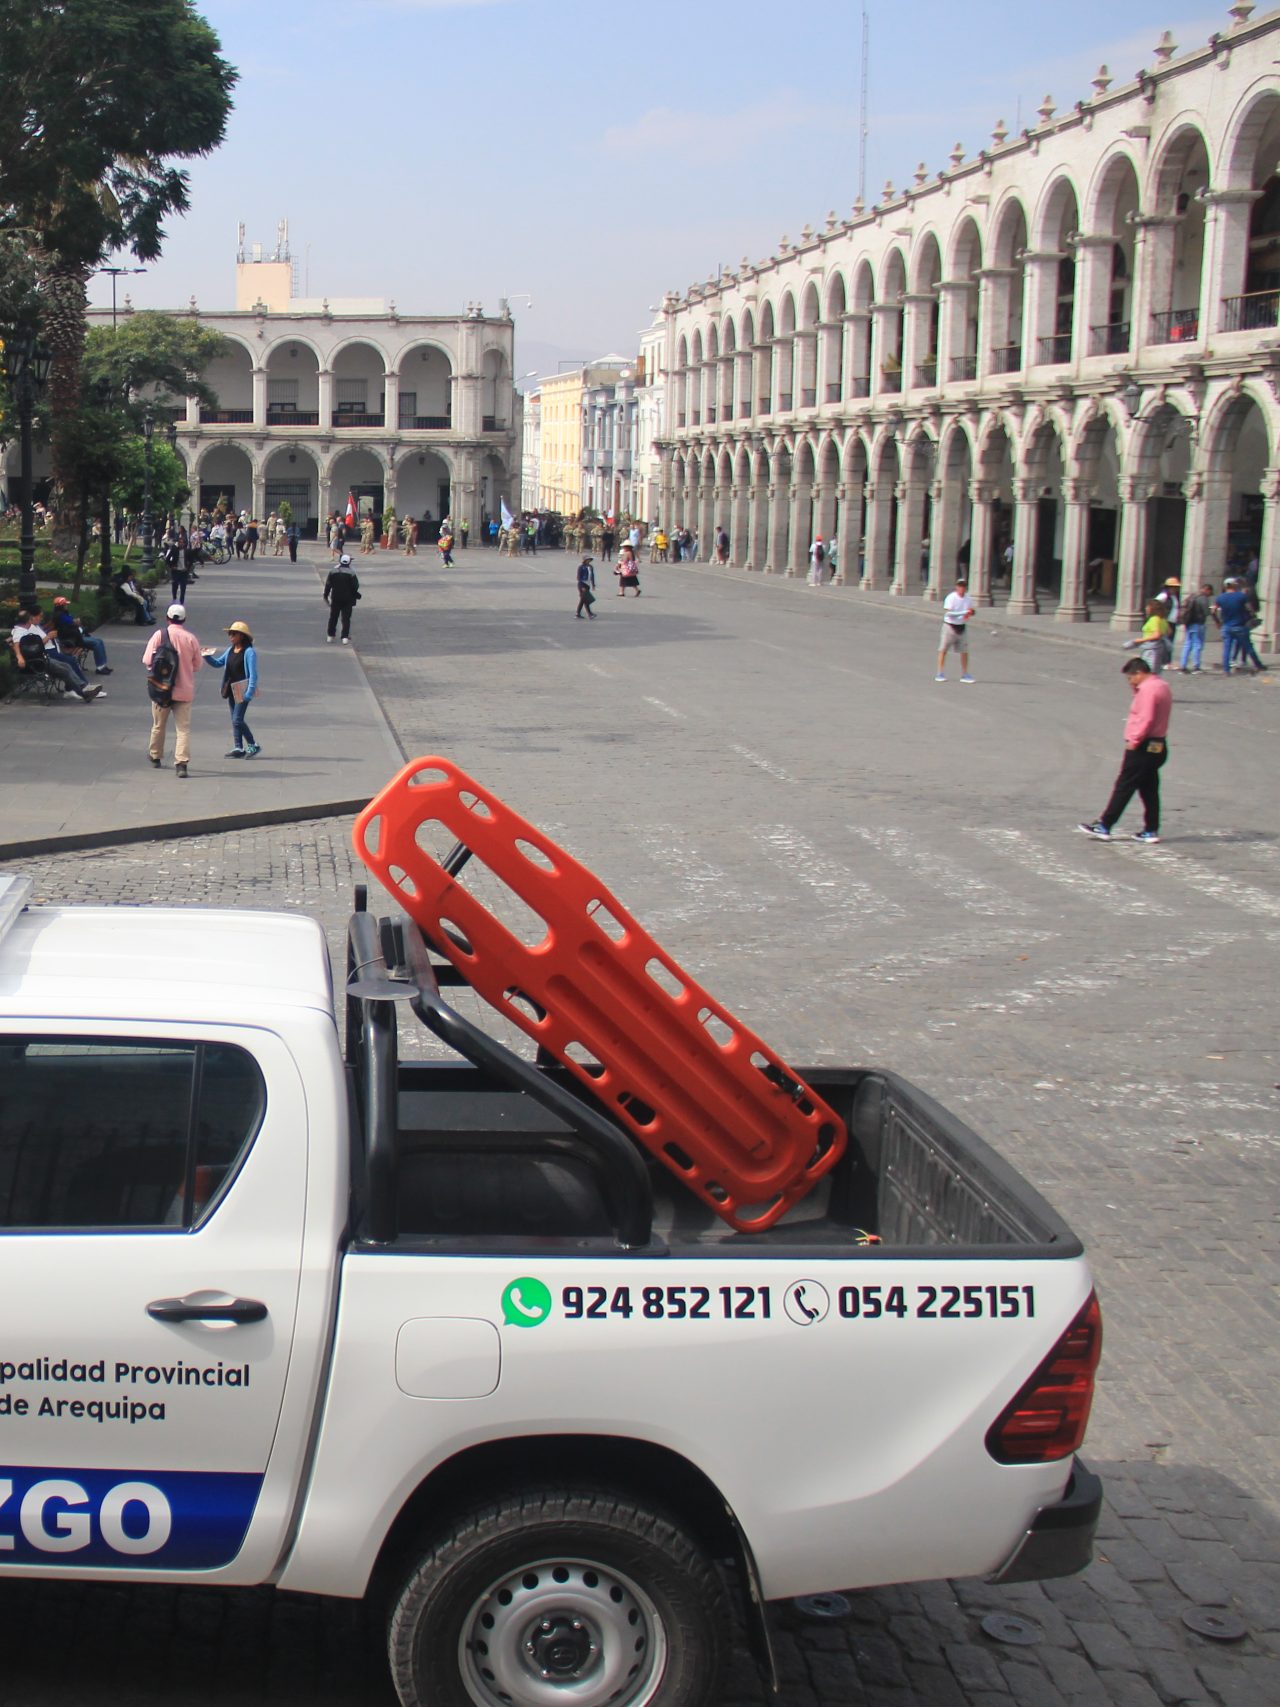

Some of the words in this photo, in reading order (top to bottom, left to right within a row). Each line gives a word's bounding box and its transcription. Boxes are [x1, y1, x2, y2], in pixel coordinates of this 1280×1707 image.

[562, 1286, 634, 1319] 924
[642, 1286, 711, 1319] 852
[720, 1286, 771, 1319] 121
[839, 1285, 908, 1318] 054
[916, 1285, 1035, 1318] 225151
[114, 1360, 250, 1387] Provincial
[37, 1395, 166, 1424] Arequipa
